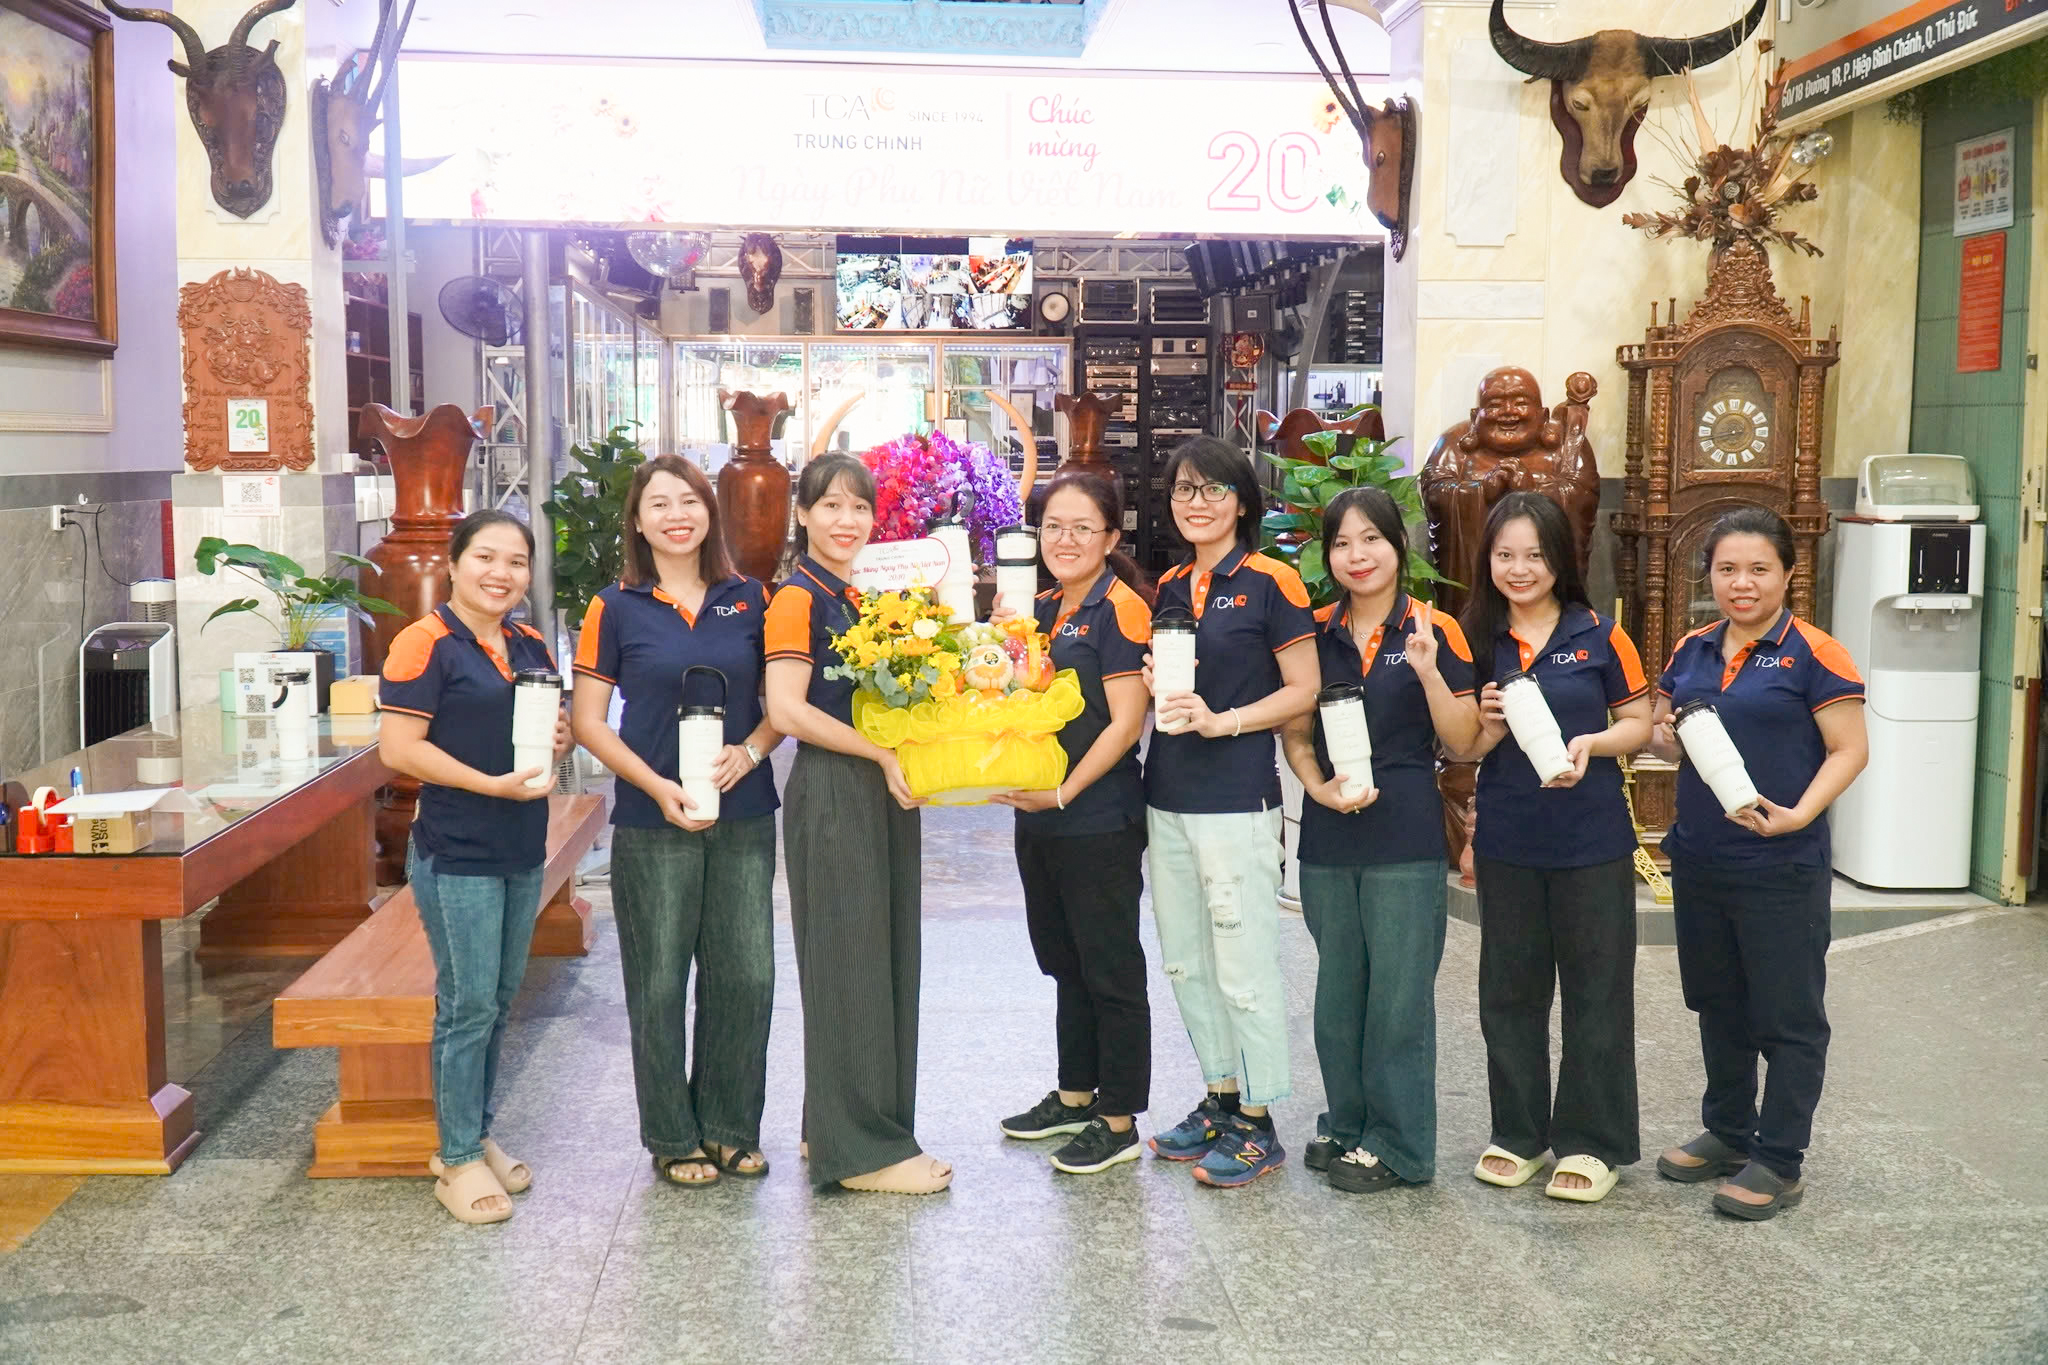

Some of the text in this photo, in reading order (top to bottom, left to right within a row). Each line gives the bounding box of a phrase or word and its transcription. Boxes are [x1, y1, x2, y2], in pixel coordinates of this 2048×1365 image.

[1805, 74, 1830, 98] Đường
[1872, 44, 1892, 70] Bình
[1893, 31, 1925, 60] Chánh,
[1935, 11, 1956, 42] Thủ
[1957, 5, 1979, 34] Đức
[907, 110, 984, 123] SINCE 1994
[1028, 92, 1095, 124] Chúc
[793, 132, 858, 150] TRUNG
[1028, 129, 1102, 173] mừng
[1207, 130, 1321, 213] 20
[729, 162, 1184, 222] Ngày Phụ Nữ Việt Nam
[235, 408, 260, 429] 20
[713, 605, 740, 617] TCA
[1384, 650, 1409, 666] TCA
[1550, 651, 1578, 665] TCA
[1755, 654, 1780, 668] TCA
